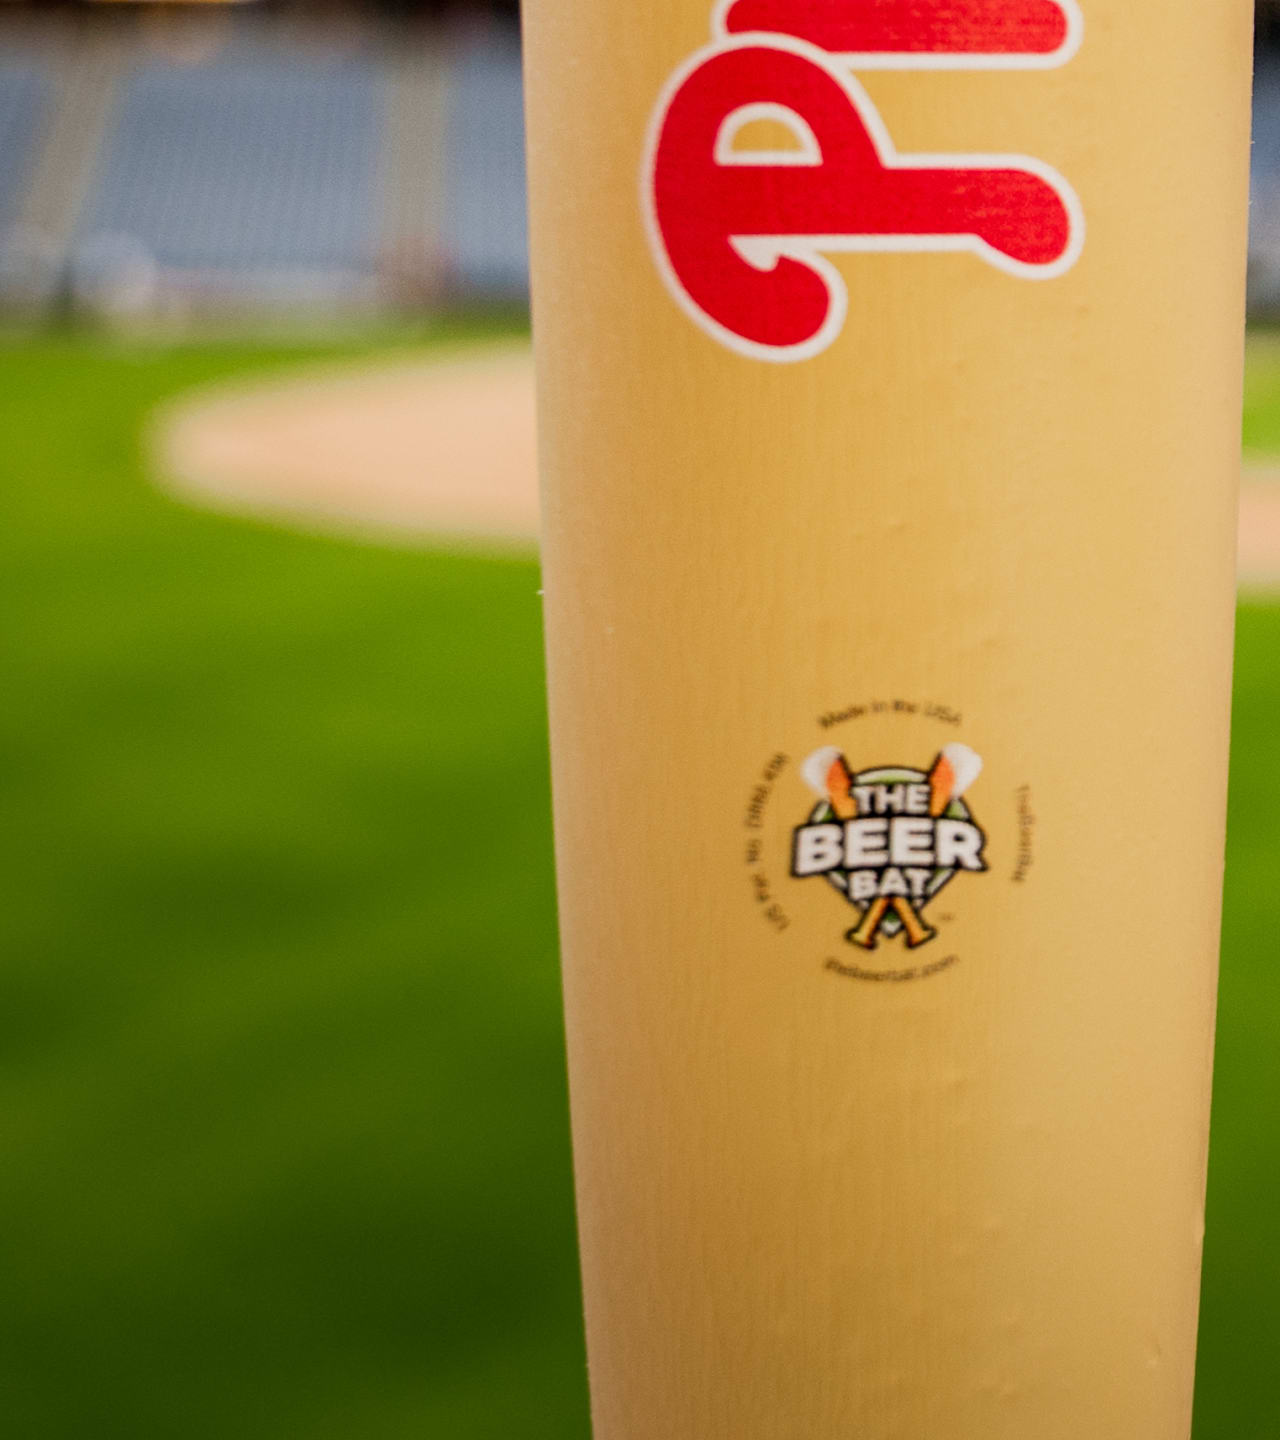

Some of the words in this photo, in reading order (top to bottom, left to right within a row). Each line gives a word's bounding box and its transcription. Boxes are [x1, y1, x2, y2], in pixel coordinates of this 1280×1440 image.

[853, 784, 931, 814] THE
[794, 817, 984, 877] BEER
[850, 869, 933, 900] BAT
